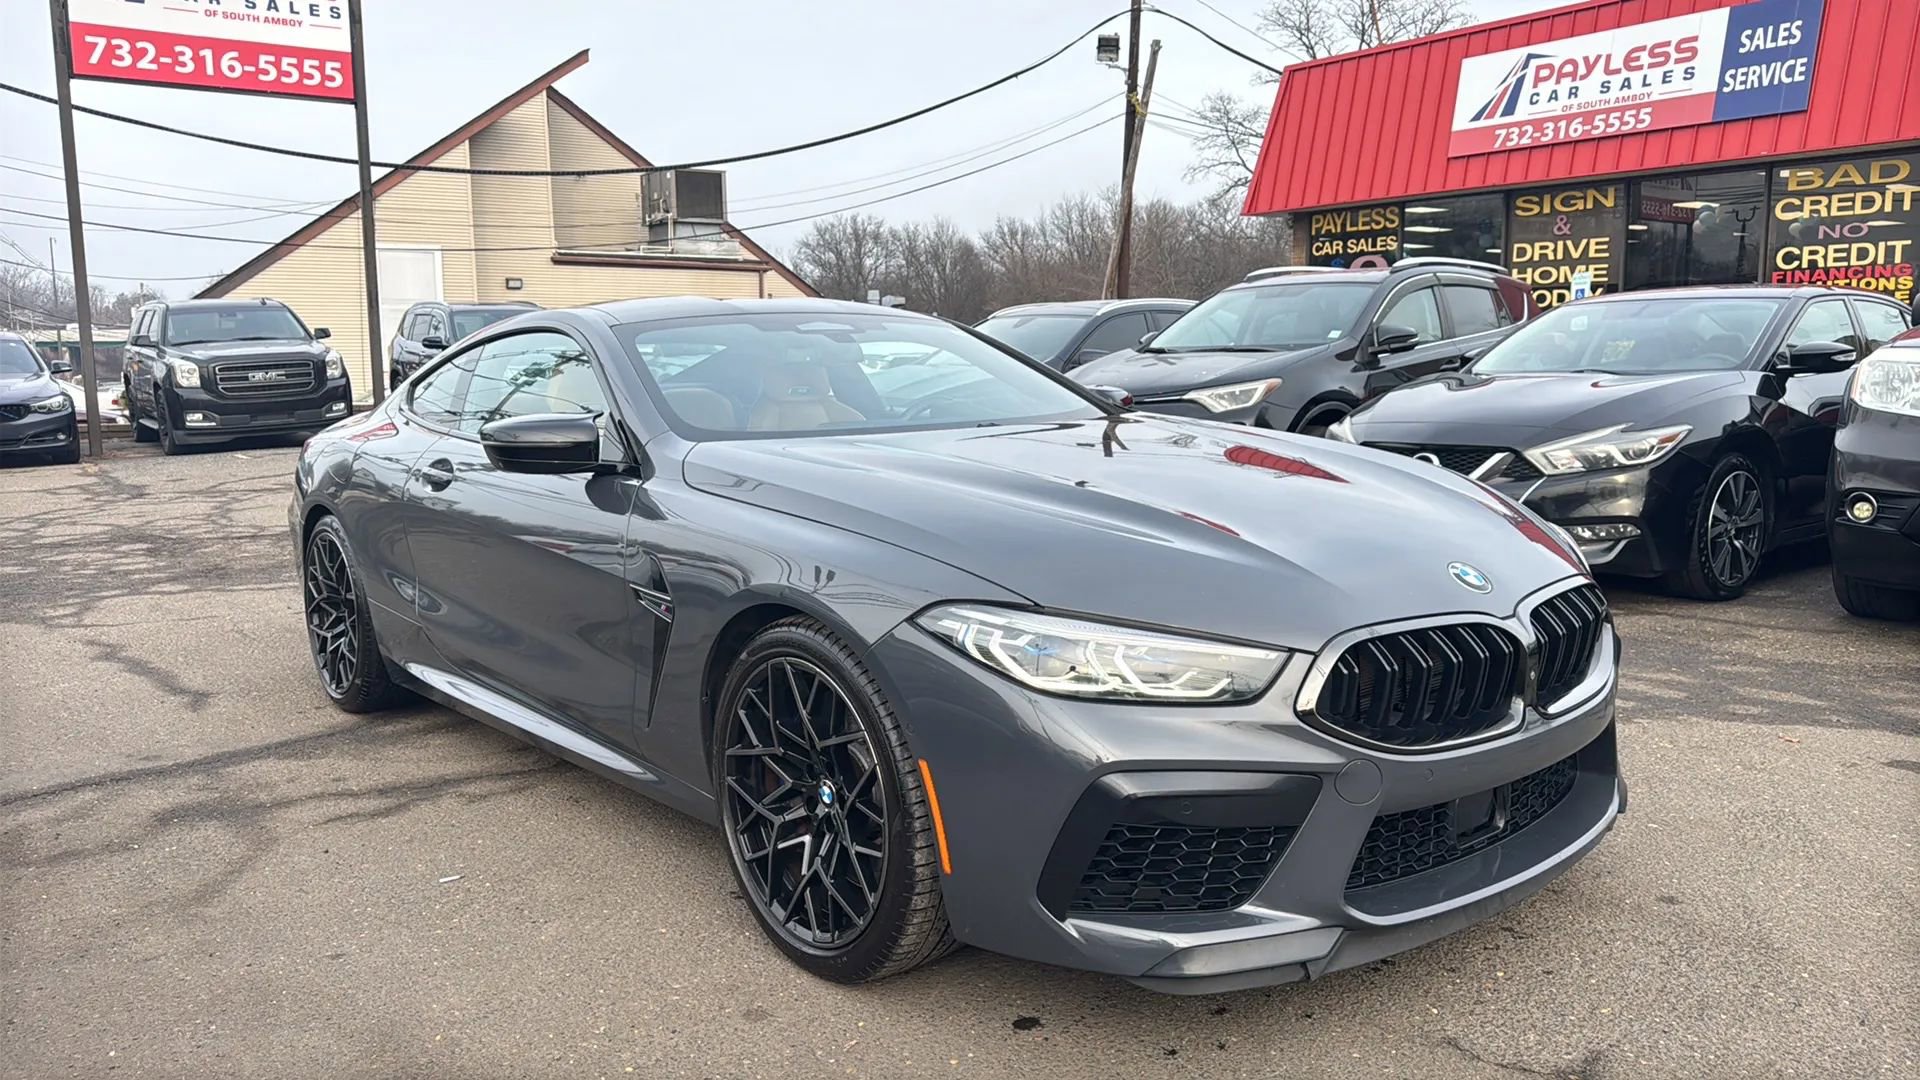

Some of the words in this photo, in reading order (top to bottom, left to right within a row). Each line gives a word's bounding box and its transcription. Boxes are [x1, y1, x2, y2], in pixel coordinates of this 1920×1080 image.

[204, 9, 220, 18] OF
[222, 11, 262, 24] SOUTH
[263, 15, 304, 28] AMBOY
[245, 0, 342, 20] SALES
[1738, 20, 1803, 53] SALES
[84, 35, 344, 88] 732-316-5555
[1532, 35, 1700, 89] PAYLESS
[1722, 57, 1808, 93] SERVICE
[1529, 86, 1580, 106] CAR
[1599, 66, 1696, 94] SALES
[1561, 104, 1575, 113] OF
[1576, 98, 1611, 111] SOUTH
[1613, 92, 1653, 105] AMBOY
[1492, 107, 1653, 149] 732-316-5555
[1787, 160, 1911, 192] BAD
[1514, 186, 1616, 217] SIGN
[1774, 190, 1917, 221] CREDIT
[1311, 206, 1400, 236] PAYLESS
[1553, 214, 1572, 236] &
[1818, 222, 1869, 239] NO
[1312, 240, 1344, 257] CAR
[1346, 235, 1399, 254] SALES
[1512, 237, 1610, 263] DRIVE
[1775, 239, 1912, 270] CREDIT
[1511, 263, 1609, 285] HOME
[1771, 263, 1913, 286] FINANCING
[248, 371, 286, 383] GMC
